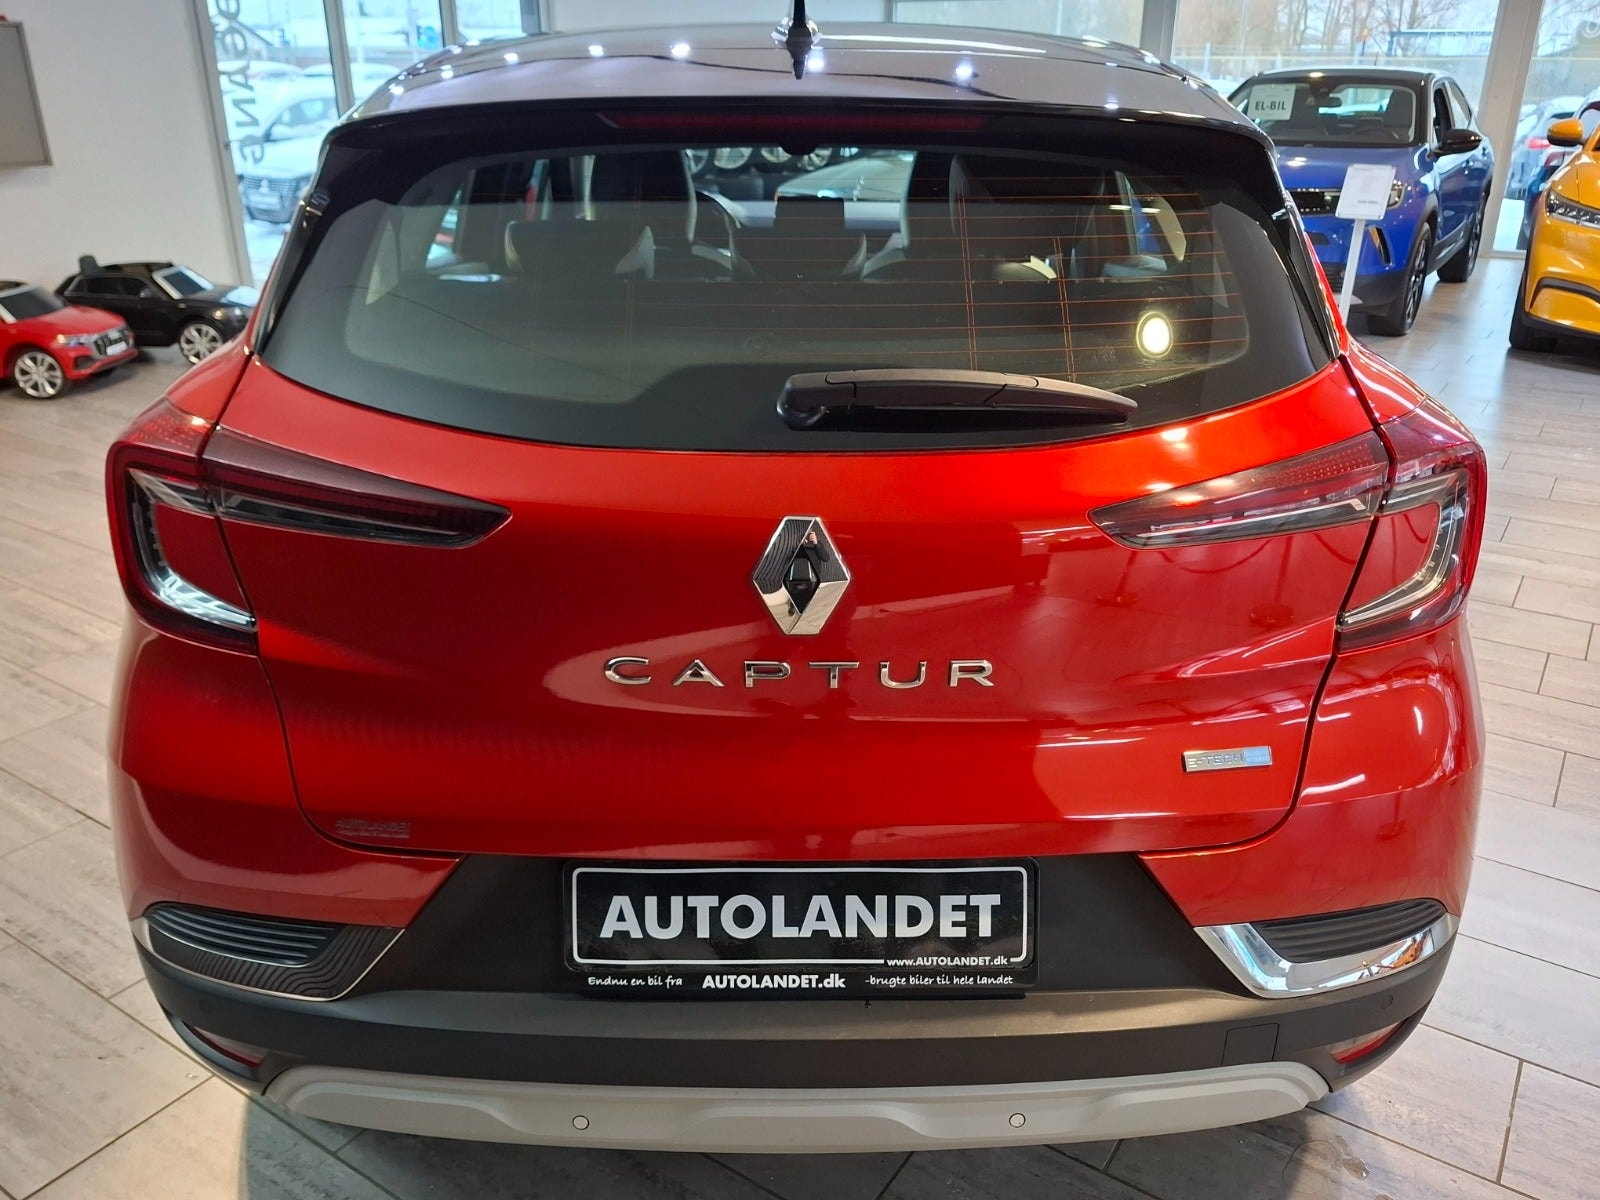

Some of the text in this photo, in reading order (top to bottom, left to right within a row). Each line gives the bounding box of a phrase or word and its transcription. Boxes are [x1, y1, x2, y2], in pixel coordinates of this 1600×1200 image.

[1255, 101, 1286, 111] EL-BIL
[604, 656, 995, 689] CAPTUR
[1187, 753, 1243, 768] E-TECH
[599, 893, 1001, 940] AUTOLANDET
[887, 956, 1008, 966] www.AUTOLANDET.dk
[588, 975, 683, 989] Endnu en bil fra
[702, 974, 846, 989] AUTOLANDET.dk
[865, 974, 1014, 987] -brugte biler til hele landet
